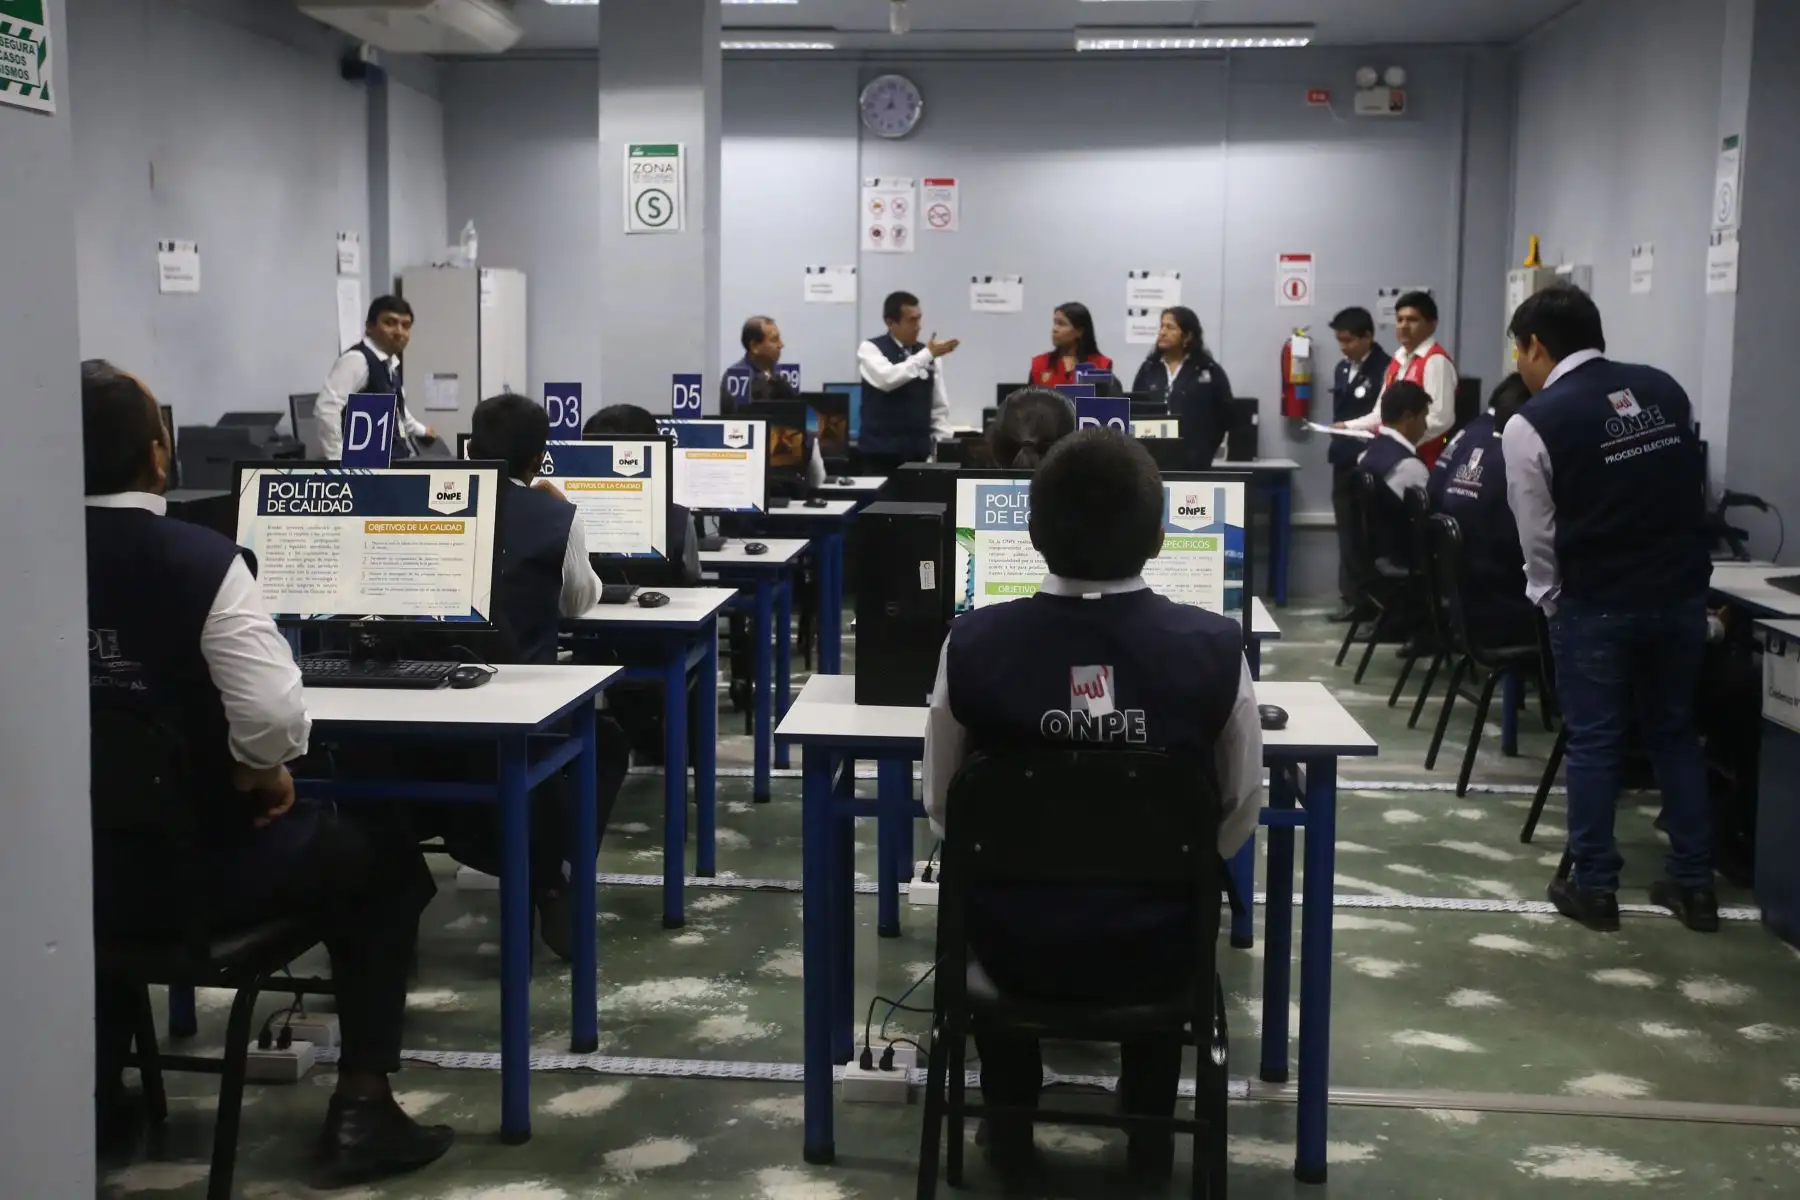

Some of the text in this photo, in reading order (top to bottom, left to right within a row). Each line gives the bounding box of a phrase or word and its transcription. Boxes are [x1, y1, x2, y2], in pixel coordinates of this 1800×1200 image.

[0, 36, 36, 55] SEGURA
[0, 64, 30, 81] ISMOS
[633, 162, 673, 174] ZONA
[648, 196, 661, 219] S
[727, 375, 750, 397] D7
[673, 383, 701, 410] D5
[545, 395, 580, 428] D3
[1605, 404, 1665, 438] ONPE
[348, 410, 390, 452] D1
[1604, 445, 1643, 464] PROCESO
[1643, 435, 1681, 454] ELECTORAL
[619, 458, 638, 466] ONPE
[267, 479, 353, 499] POLÍTICA
[436, 492, 461, 501] ONPE
[267, 501, 353, 513] DE CALIDAD
[986, 492, 1029, 508] POLÍT
[985, 510, 1008, 524] DE
[1178, 506, 1206, 515] ONPE
[368, 523, 462, 533] OBJETIVOS DE LA CALIDAD
[998, 585, 1036, 593] OBJETIVO
[1041, 709, 1147, 743] ONPE
